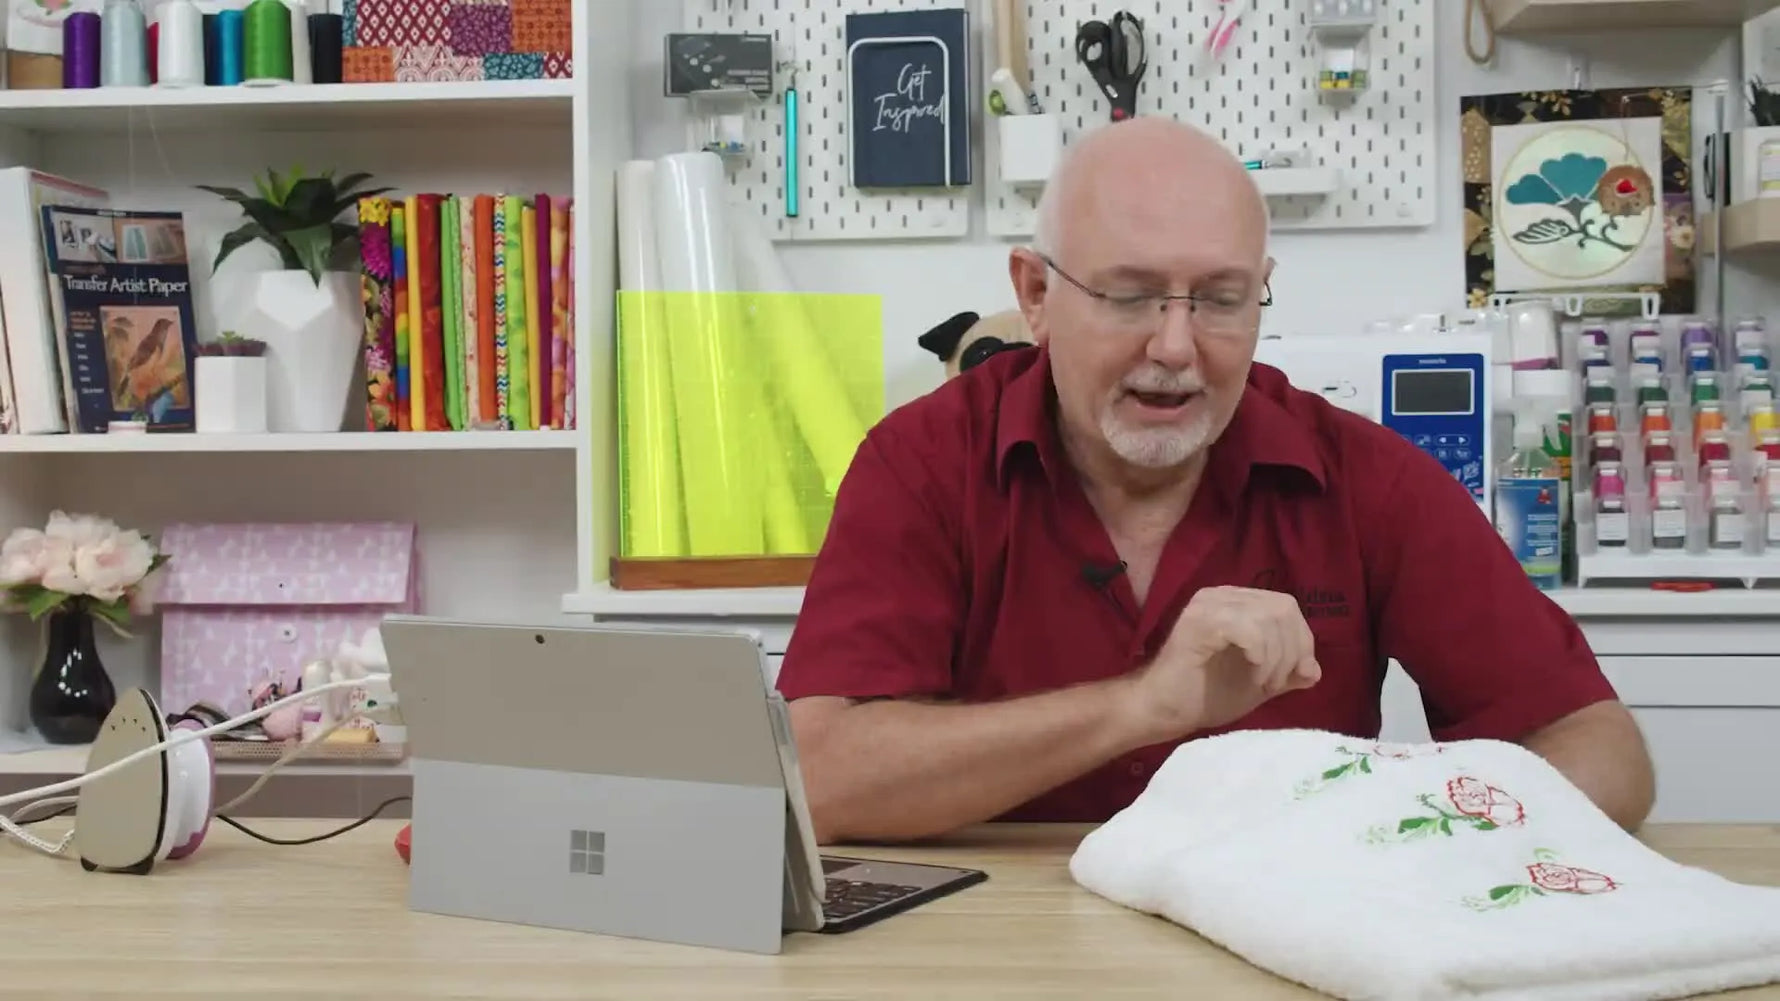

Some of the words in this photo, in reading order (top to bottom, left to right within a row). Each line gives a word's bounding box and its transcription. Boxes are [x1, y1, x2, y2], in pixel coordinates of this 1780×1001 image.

[897, 63, 932, 101] Get
[65, 275, 108, 291] Transfer
[110, 277, 147, 292] Artist
[148, 278, 188, 297] Paper
